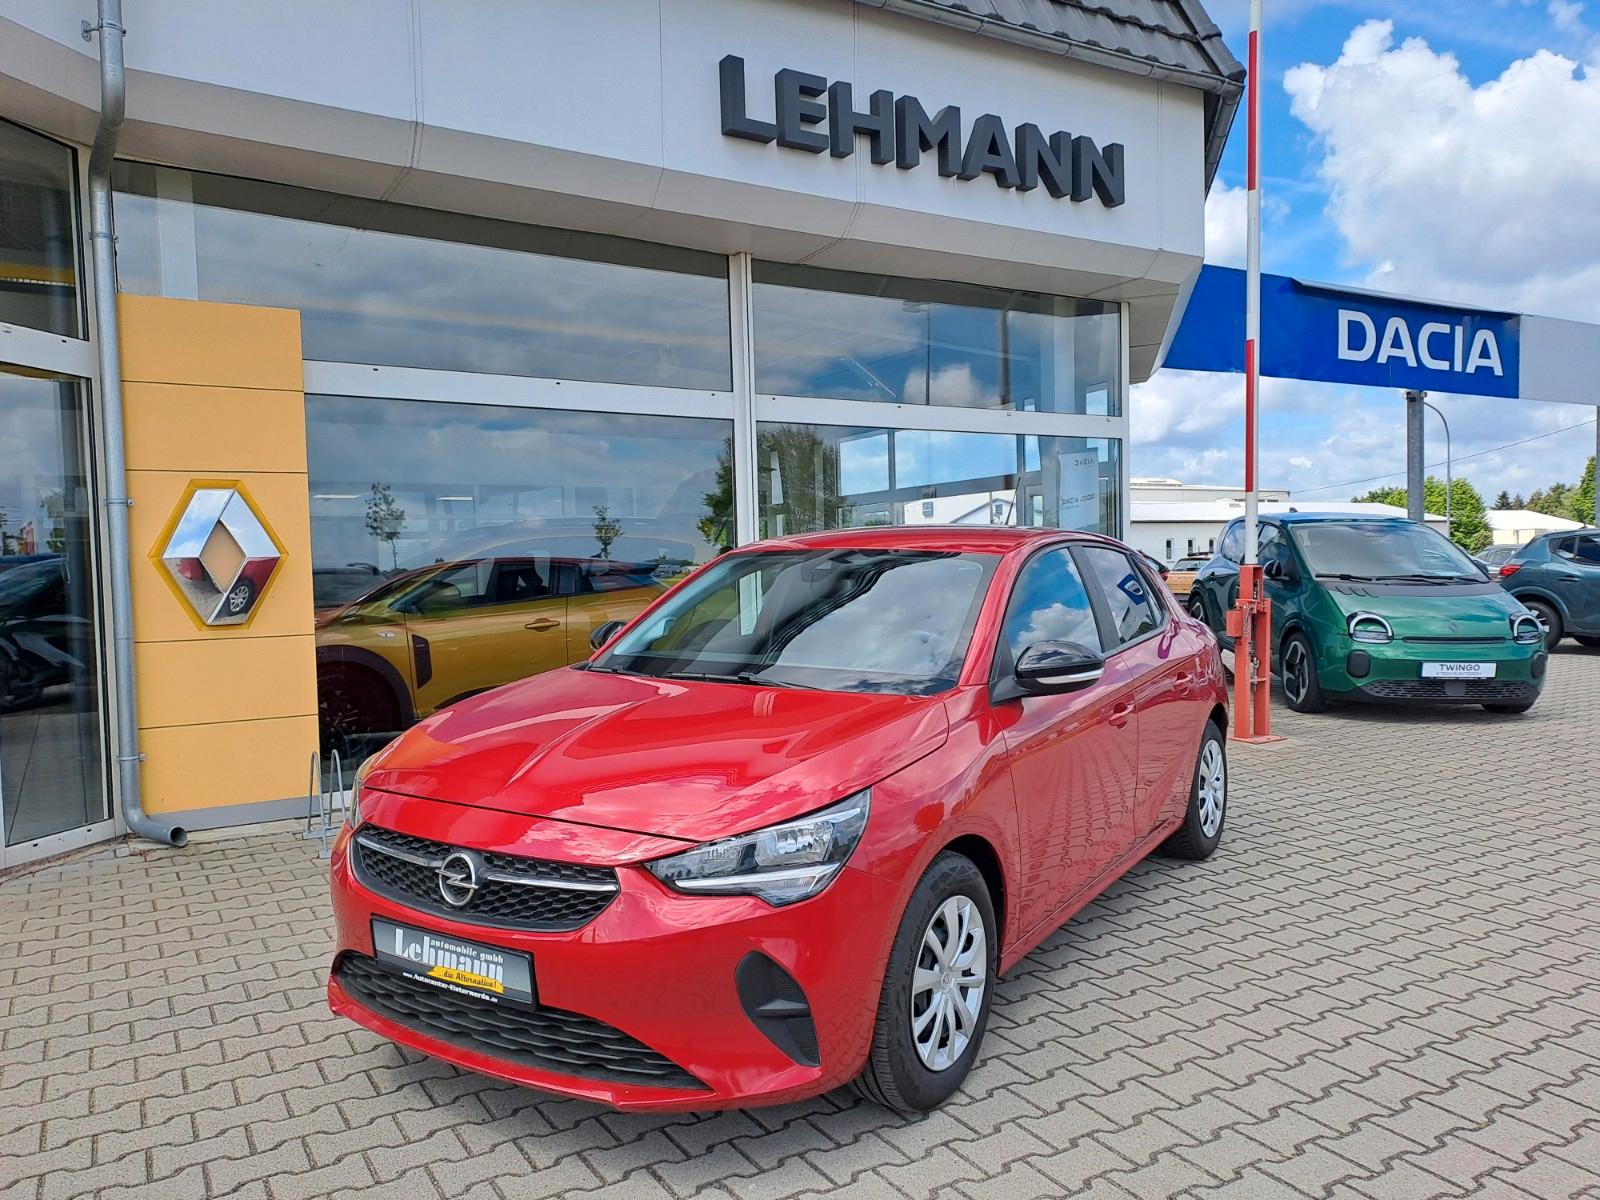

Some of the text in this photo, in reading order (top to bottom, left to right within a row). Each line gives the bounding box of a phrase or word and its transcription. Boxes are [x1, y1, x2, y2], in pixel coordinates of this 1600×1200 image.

[719, 54, 1125, 208] LEHMANN
[1337, 309, 1504, 377] DACIA
[395, 928, 504, 984] Lehmann
[430, 939, 504, 964] automobile gmbh
